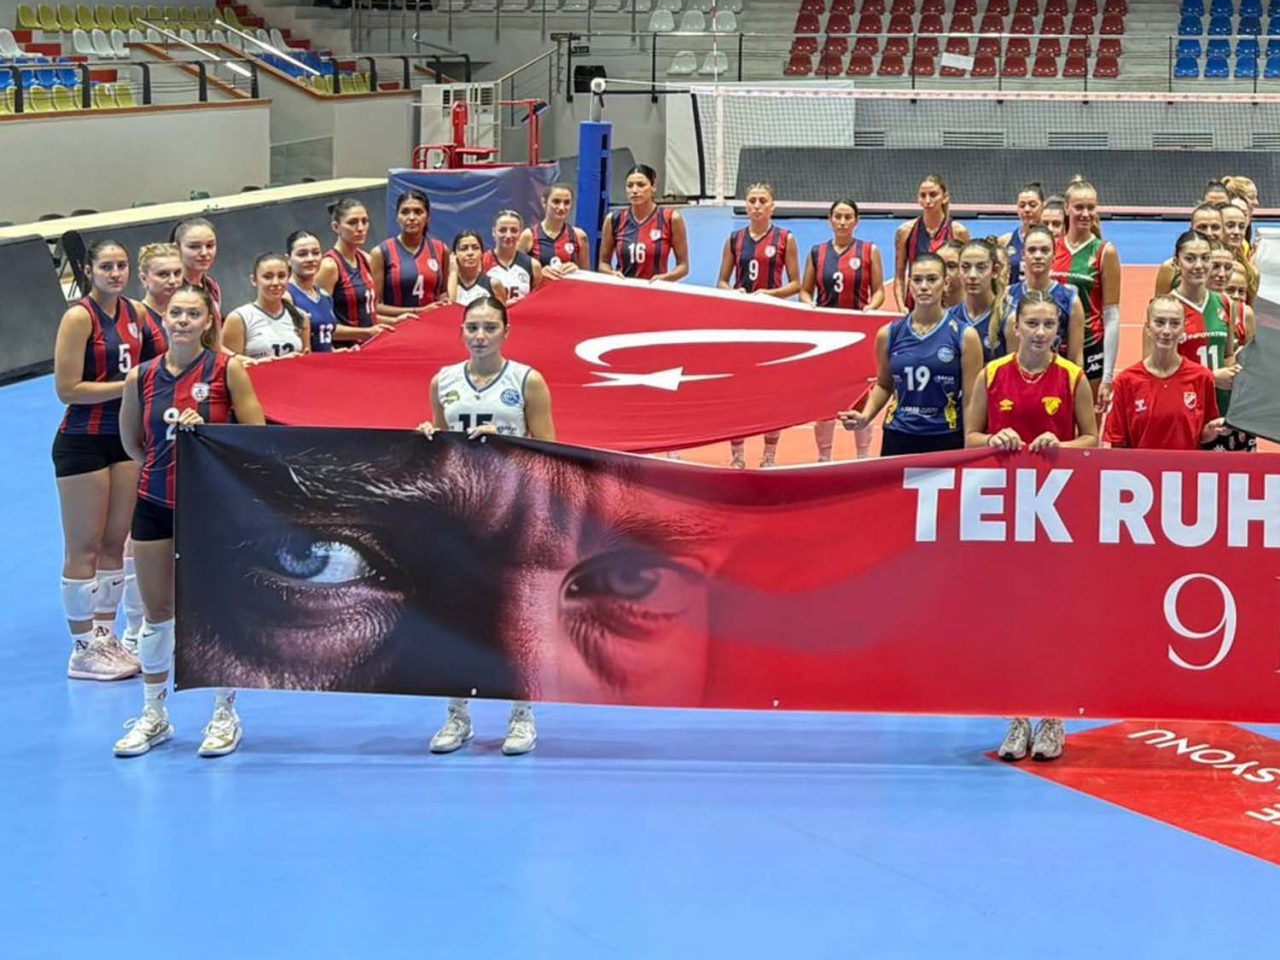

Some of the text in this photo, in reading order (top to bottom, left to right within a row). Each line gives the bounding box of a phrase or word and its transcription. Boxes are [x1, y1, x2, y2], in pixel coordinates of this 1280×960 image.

[628, 242, 646, 264] 16
[749, 259, 759, 281] 9
[832, 271, 844, 293] 3
[412, 274, 424, 299] 4
[118, 343, 131, 373] 5
[1196, 345, 1219, 370] 11
[904, 366, 931, 391] 19
[903, 467, 1074, 543] TEK
[1163, 572, 1238, 671] 9
